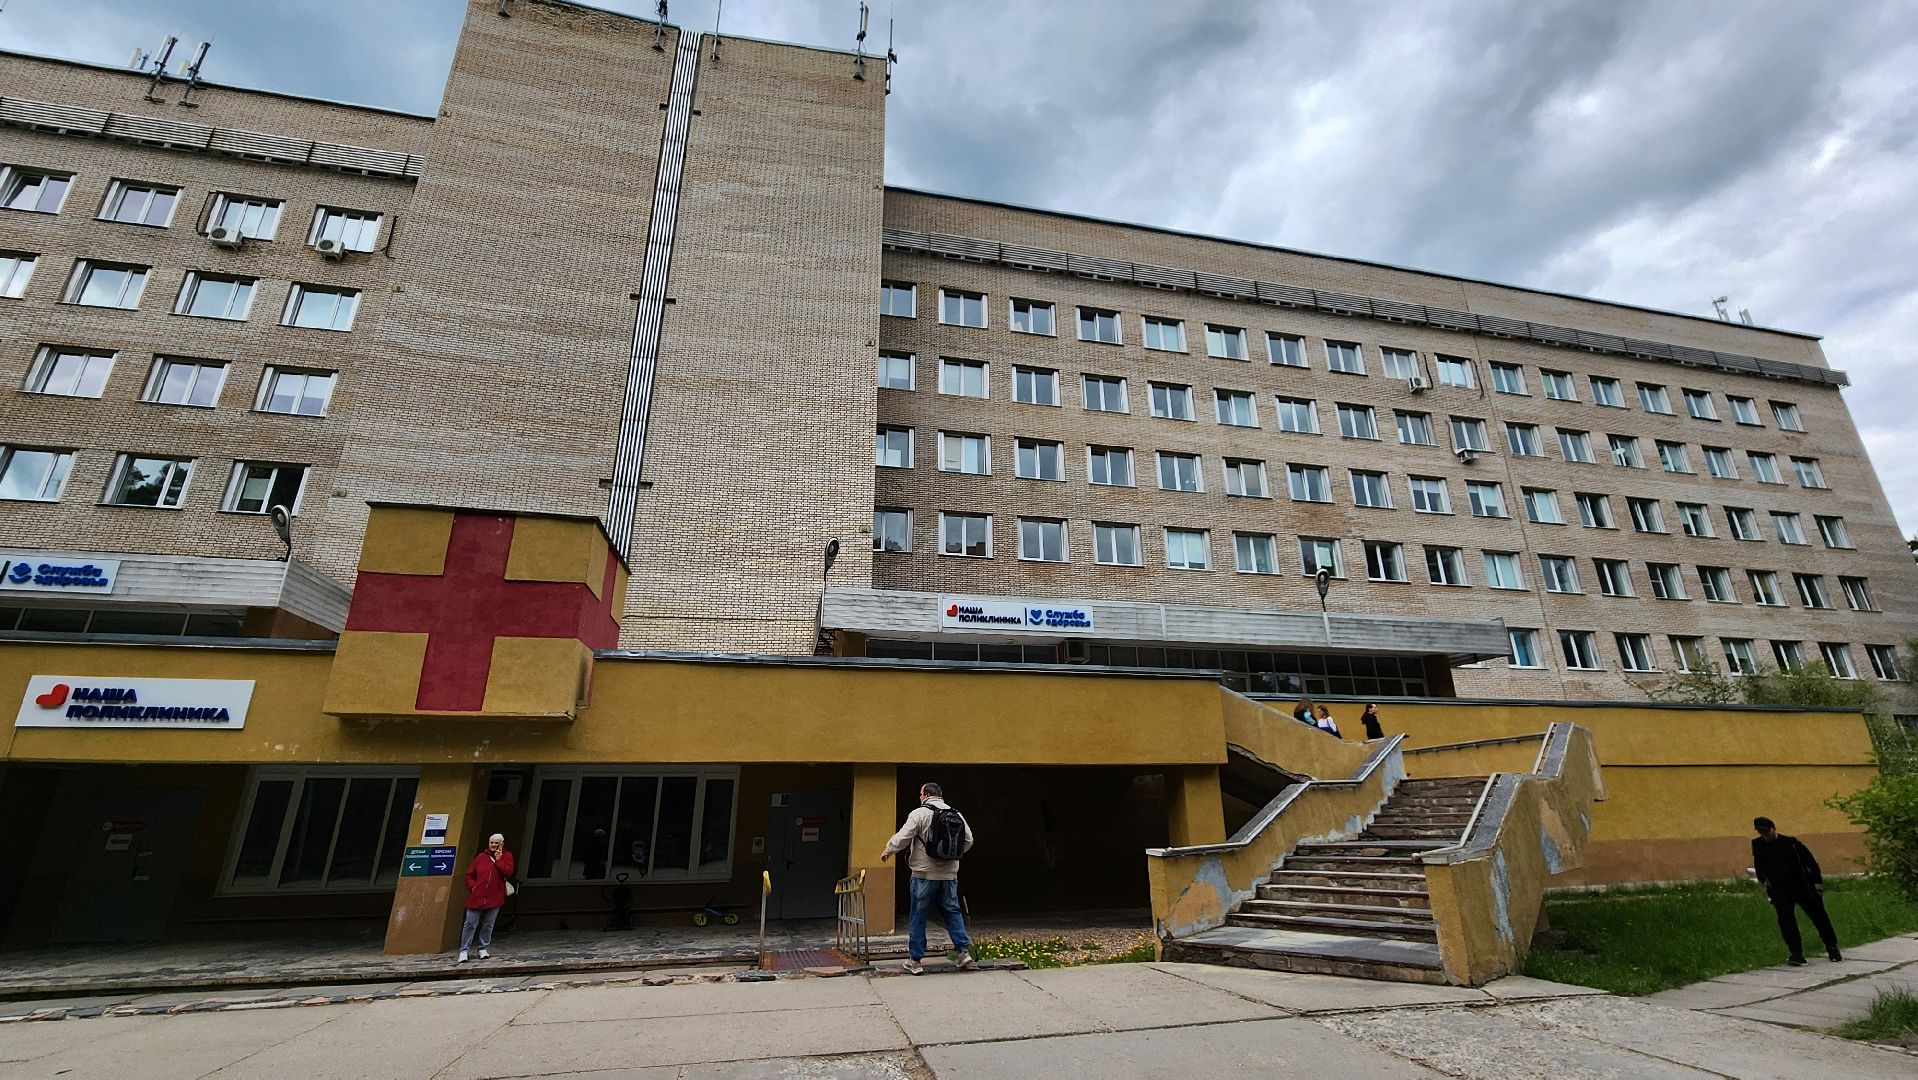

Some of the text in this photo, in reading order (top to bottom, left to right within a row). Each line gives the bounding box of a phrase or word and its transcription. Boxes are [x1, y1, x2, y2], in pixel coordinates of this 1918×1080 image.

[958, 606, 983, 614] НАША
[1045, 609, 1086, 620] Служба
[958, 615, 1022, 625] ПОЛИКЛИНИКА
[71, 687, 138, 703] НАША
[65, 705, 230, 722] ПОЛИКЛИНИКА
